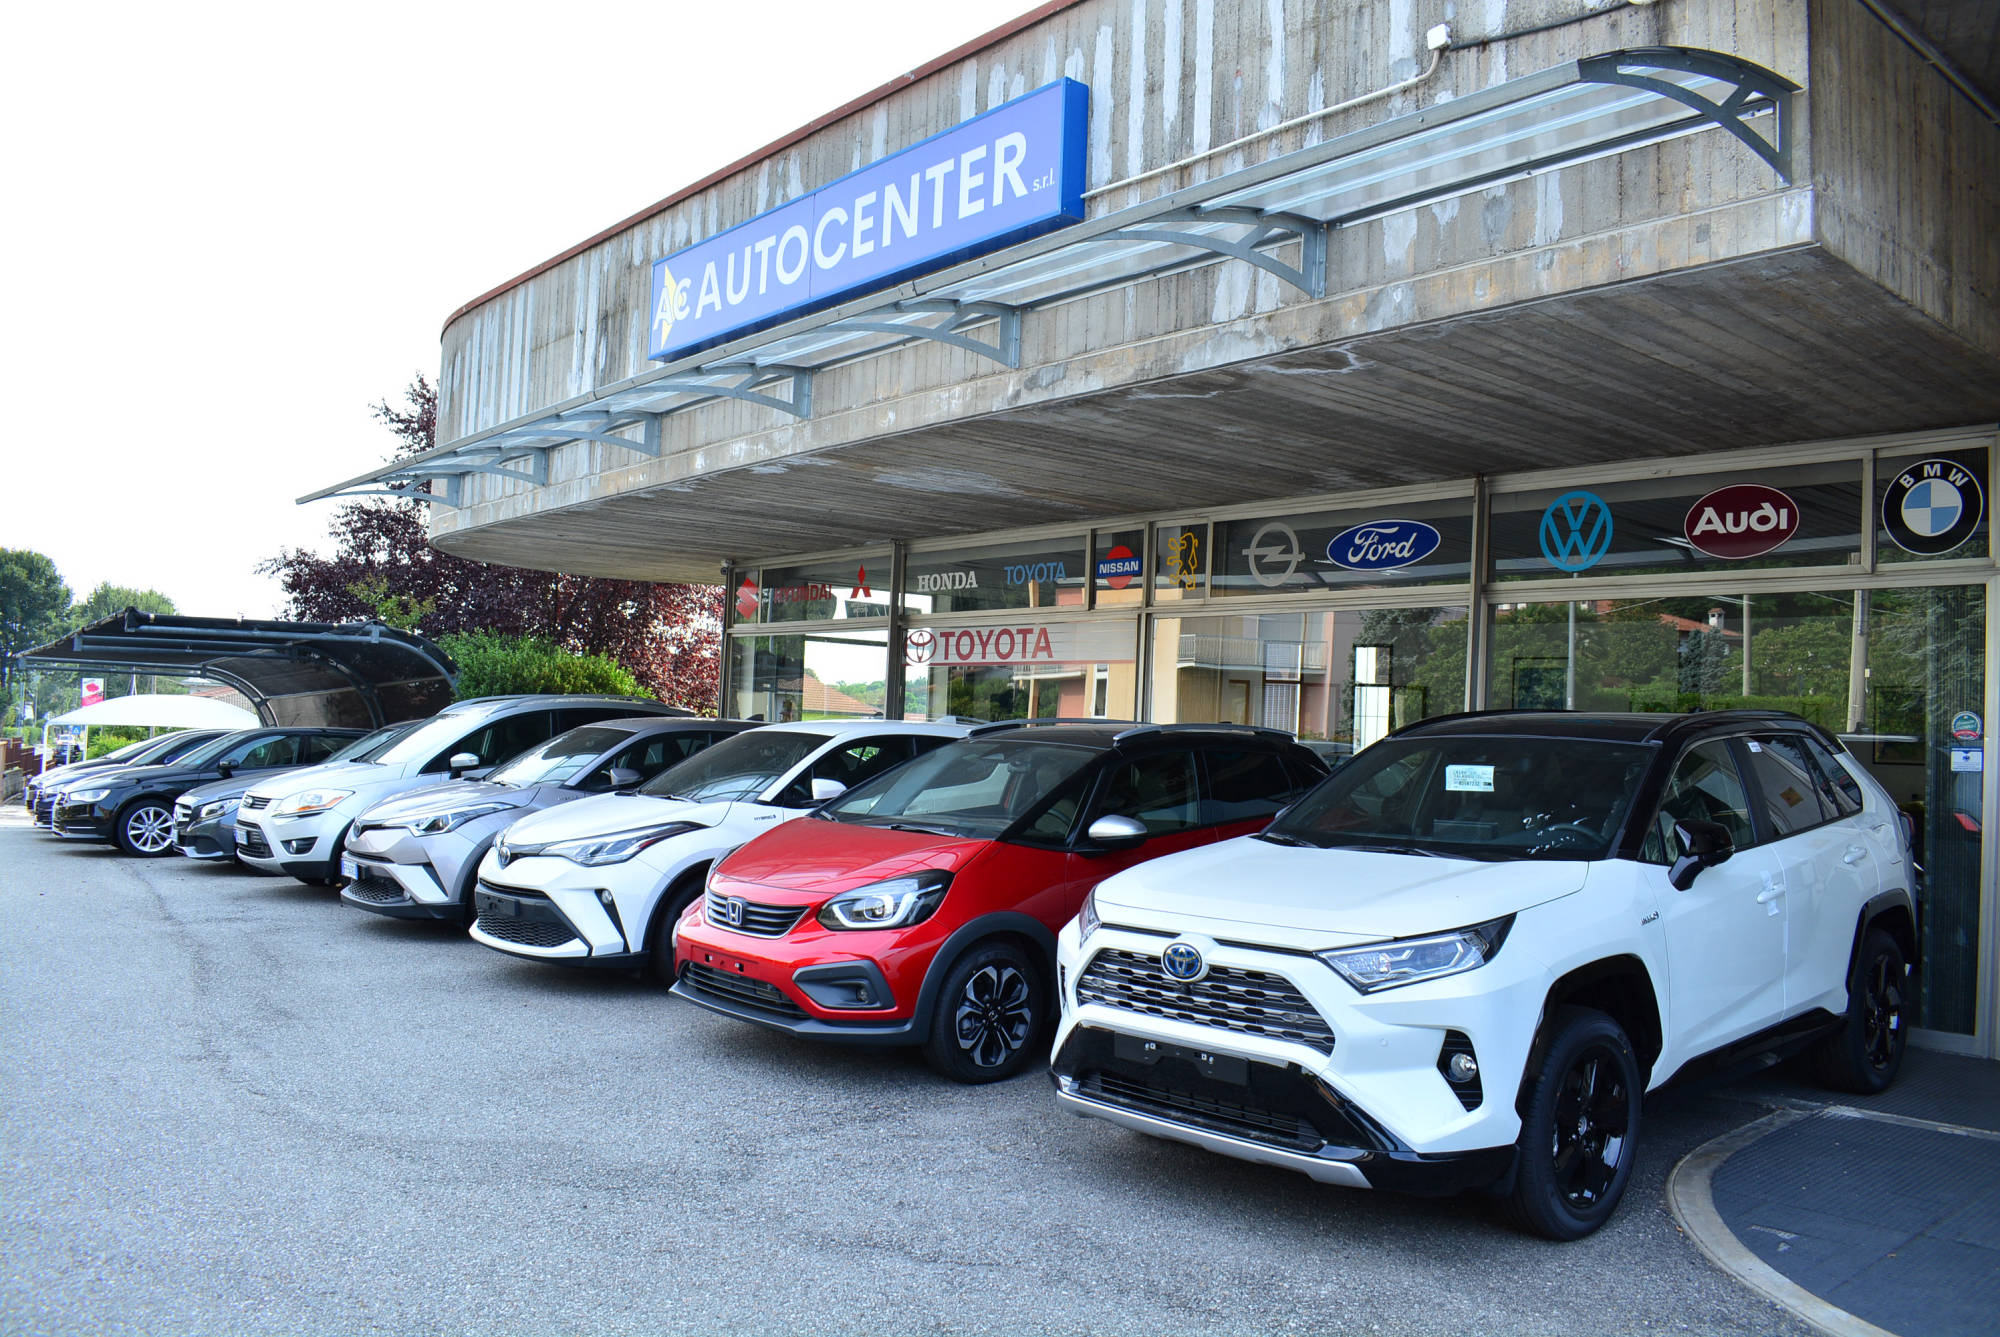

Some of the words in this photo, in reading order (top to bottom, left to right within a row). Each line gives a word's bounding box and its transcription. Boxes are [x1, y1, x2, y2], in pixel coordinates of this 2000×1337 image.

[695, 131, 1028, 319] AUTOCENTER
[1899, 462, 1968, 488] BMW
[1348, 527, 1415, 564] Ford
[1004, 561, 1067, 585] TOYOTA
[1099, 558, 1139, 575] NISSAN
[774, 584, 832, 602] HYUNDAI
[917, 570, 978, 592] HONDA
[939, 627, 1053, 660] TOYOTA
